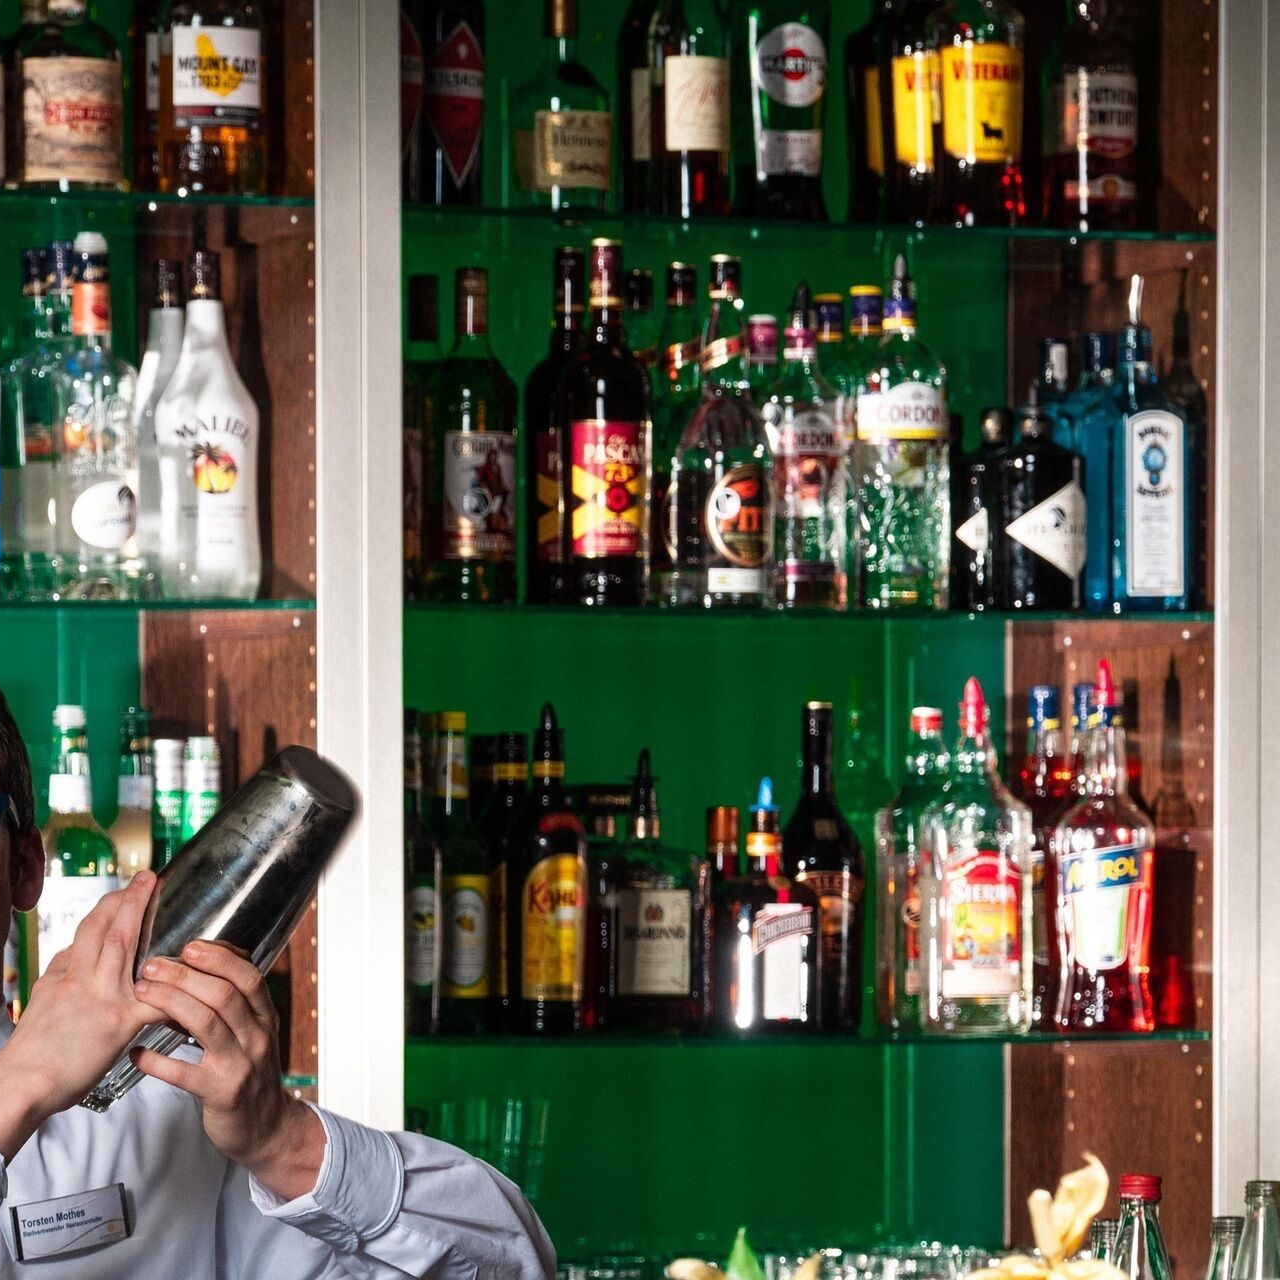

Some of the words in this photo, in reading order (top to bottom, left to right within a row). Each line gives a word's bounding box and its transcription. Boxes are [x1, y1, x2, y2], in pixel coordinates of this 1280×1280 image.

[1065, 856, 1139, 892] AROL
[21, 1216, 55, 1229] Torsten
[56, 1208, 86, 1221] Mothes
[22, 1225, 65, 1238] Stellvertretender
